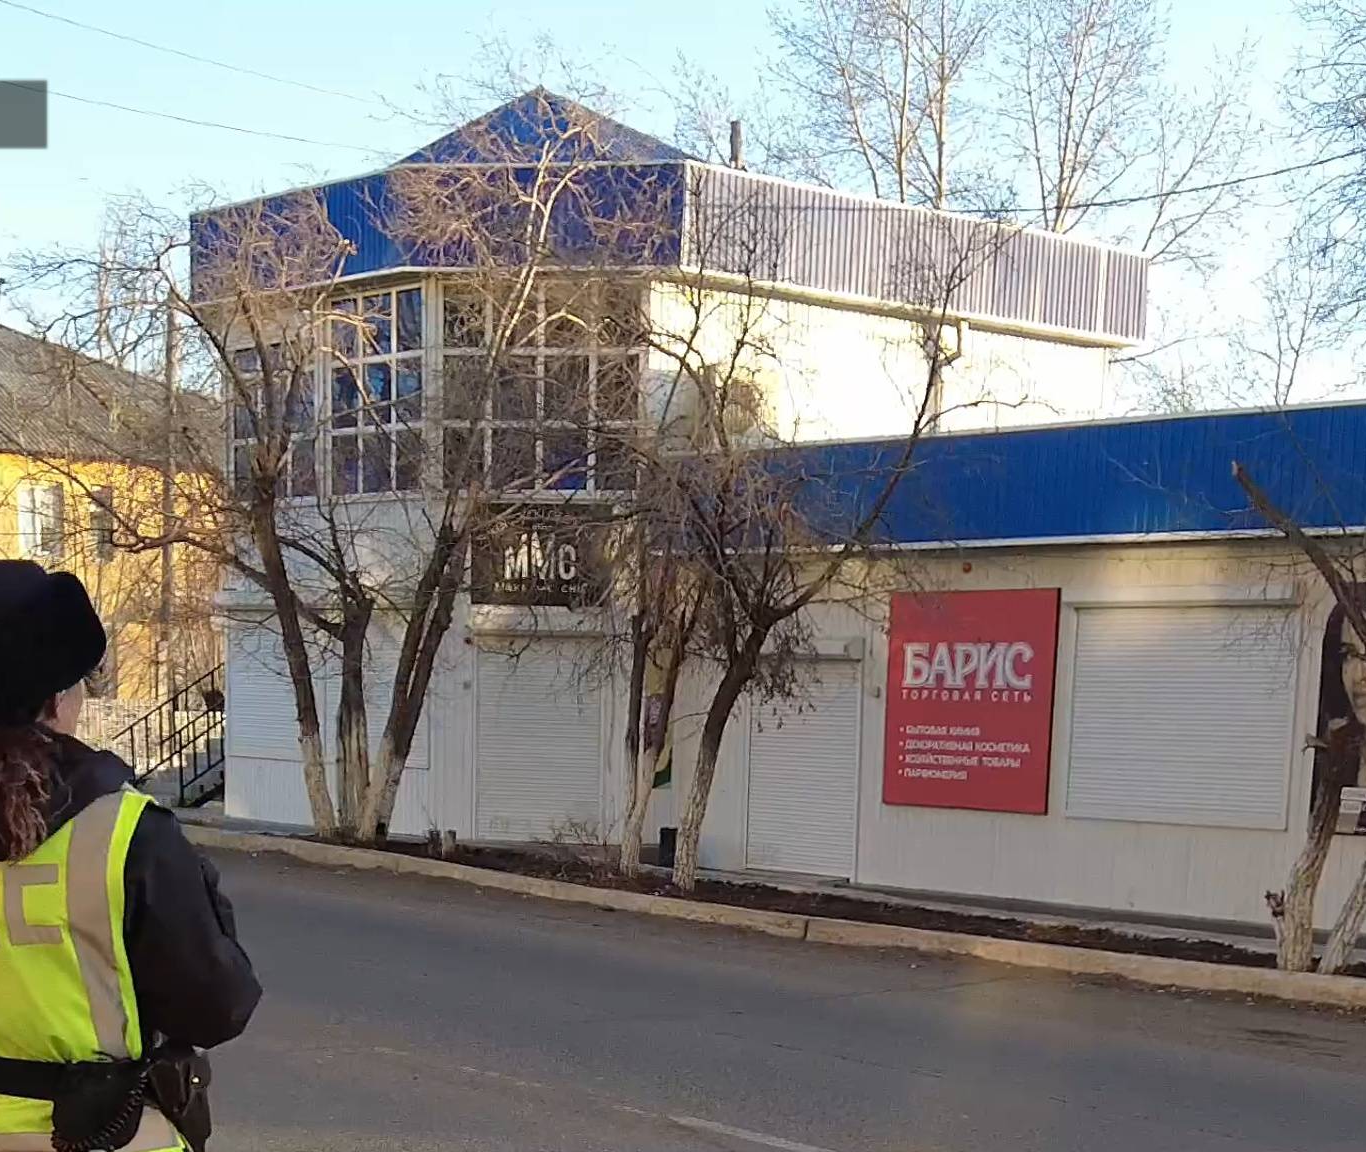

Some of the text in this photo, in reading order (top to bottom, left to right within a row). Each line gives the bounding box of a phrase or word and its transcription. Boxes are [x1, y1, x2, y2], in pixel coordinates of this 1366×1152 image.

[901, 640, 1035, 690] БАРИС
[901, 689, 1032, 703] ТОРГОВАЯ СЕТЬ
